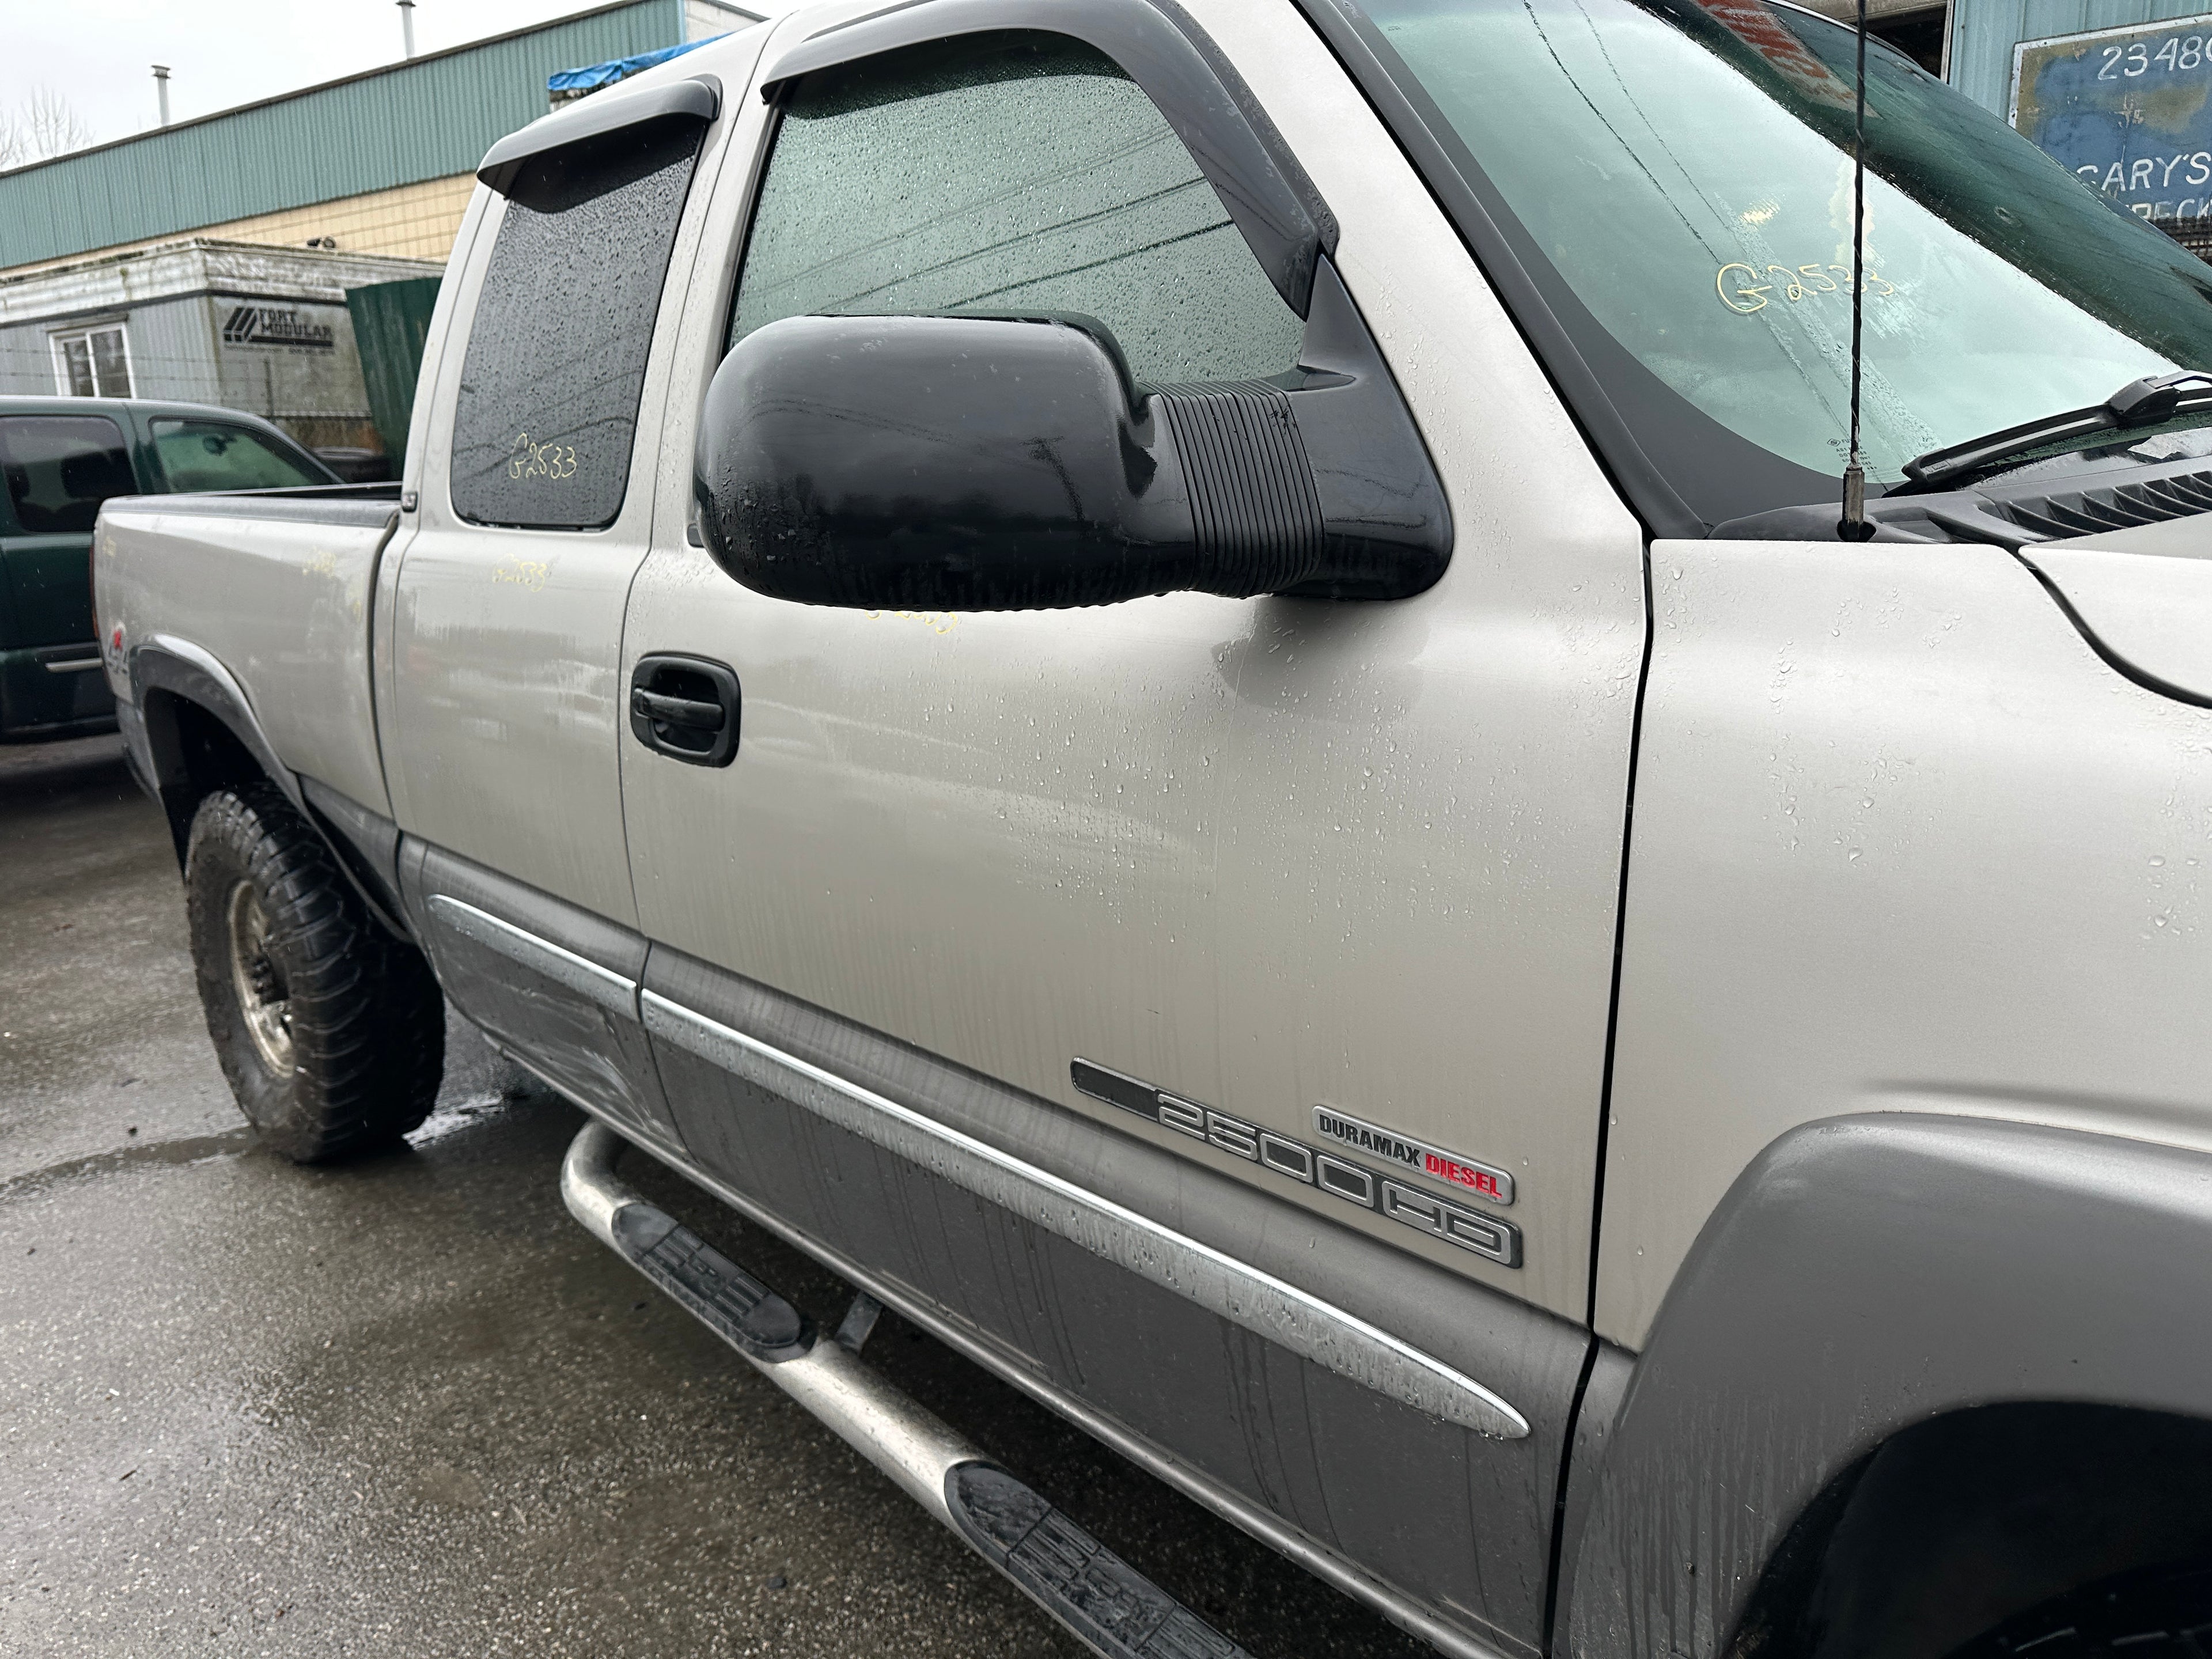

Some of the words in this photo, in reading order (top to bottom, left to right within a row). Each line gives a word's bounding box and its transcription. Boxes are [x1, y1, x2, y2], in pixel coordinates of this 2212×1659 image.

[509, 433, 577, 479] G2533
[1319, 1113, 1421, 1168] DURAMAX
[1425, 1153, 1502, 1199] DIESEL
